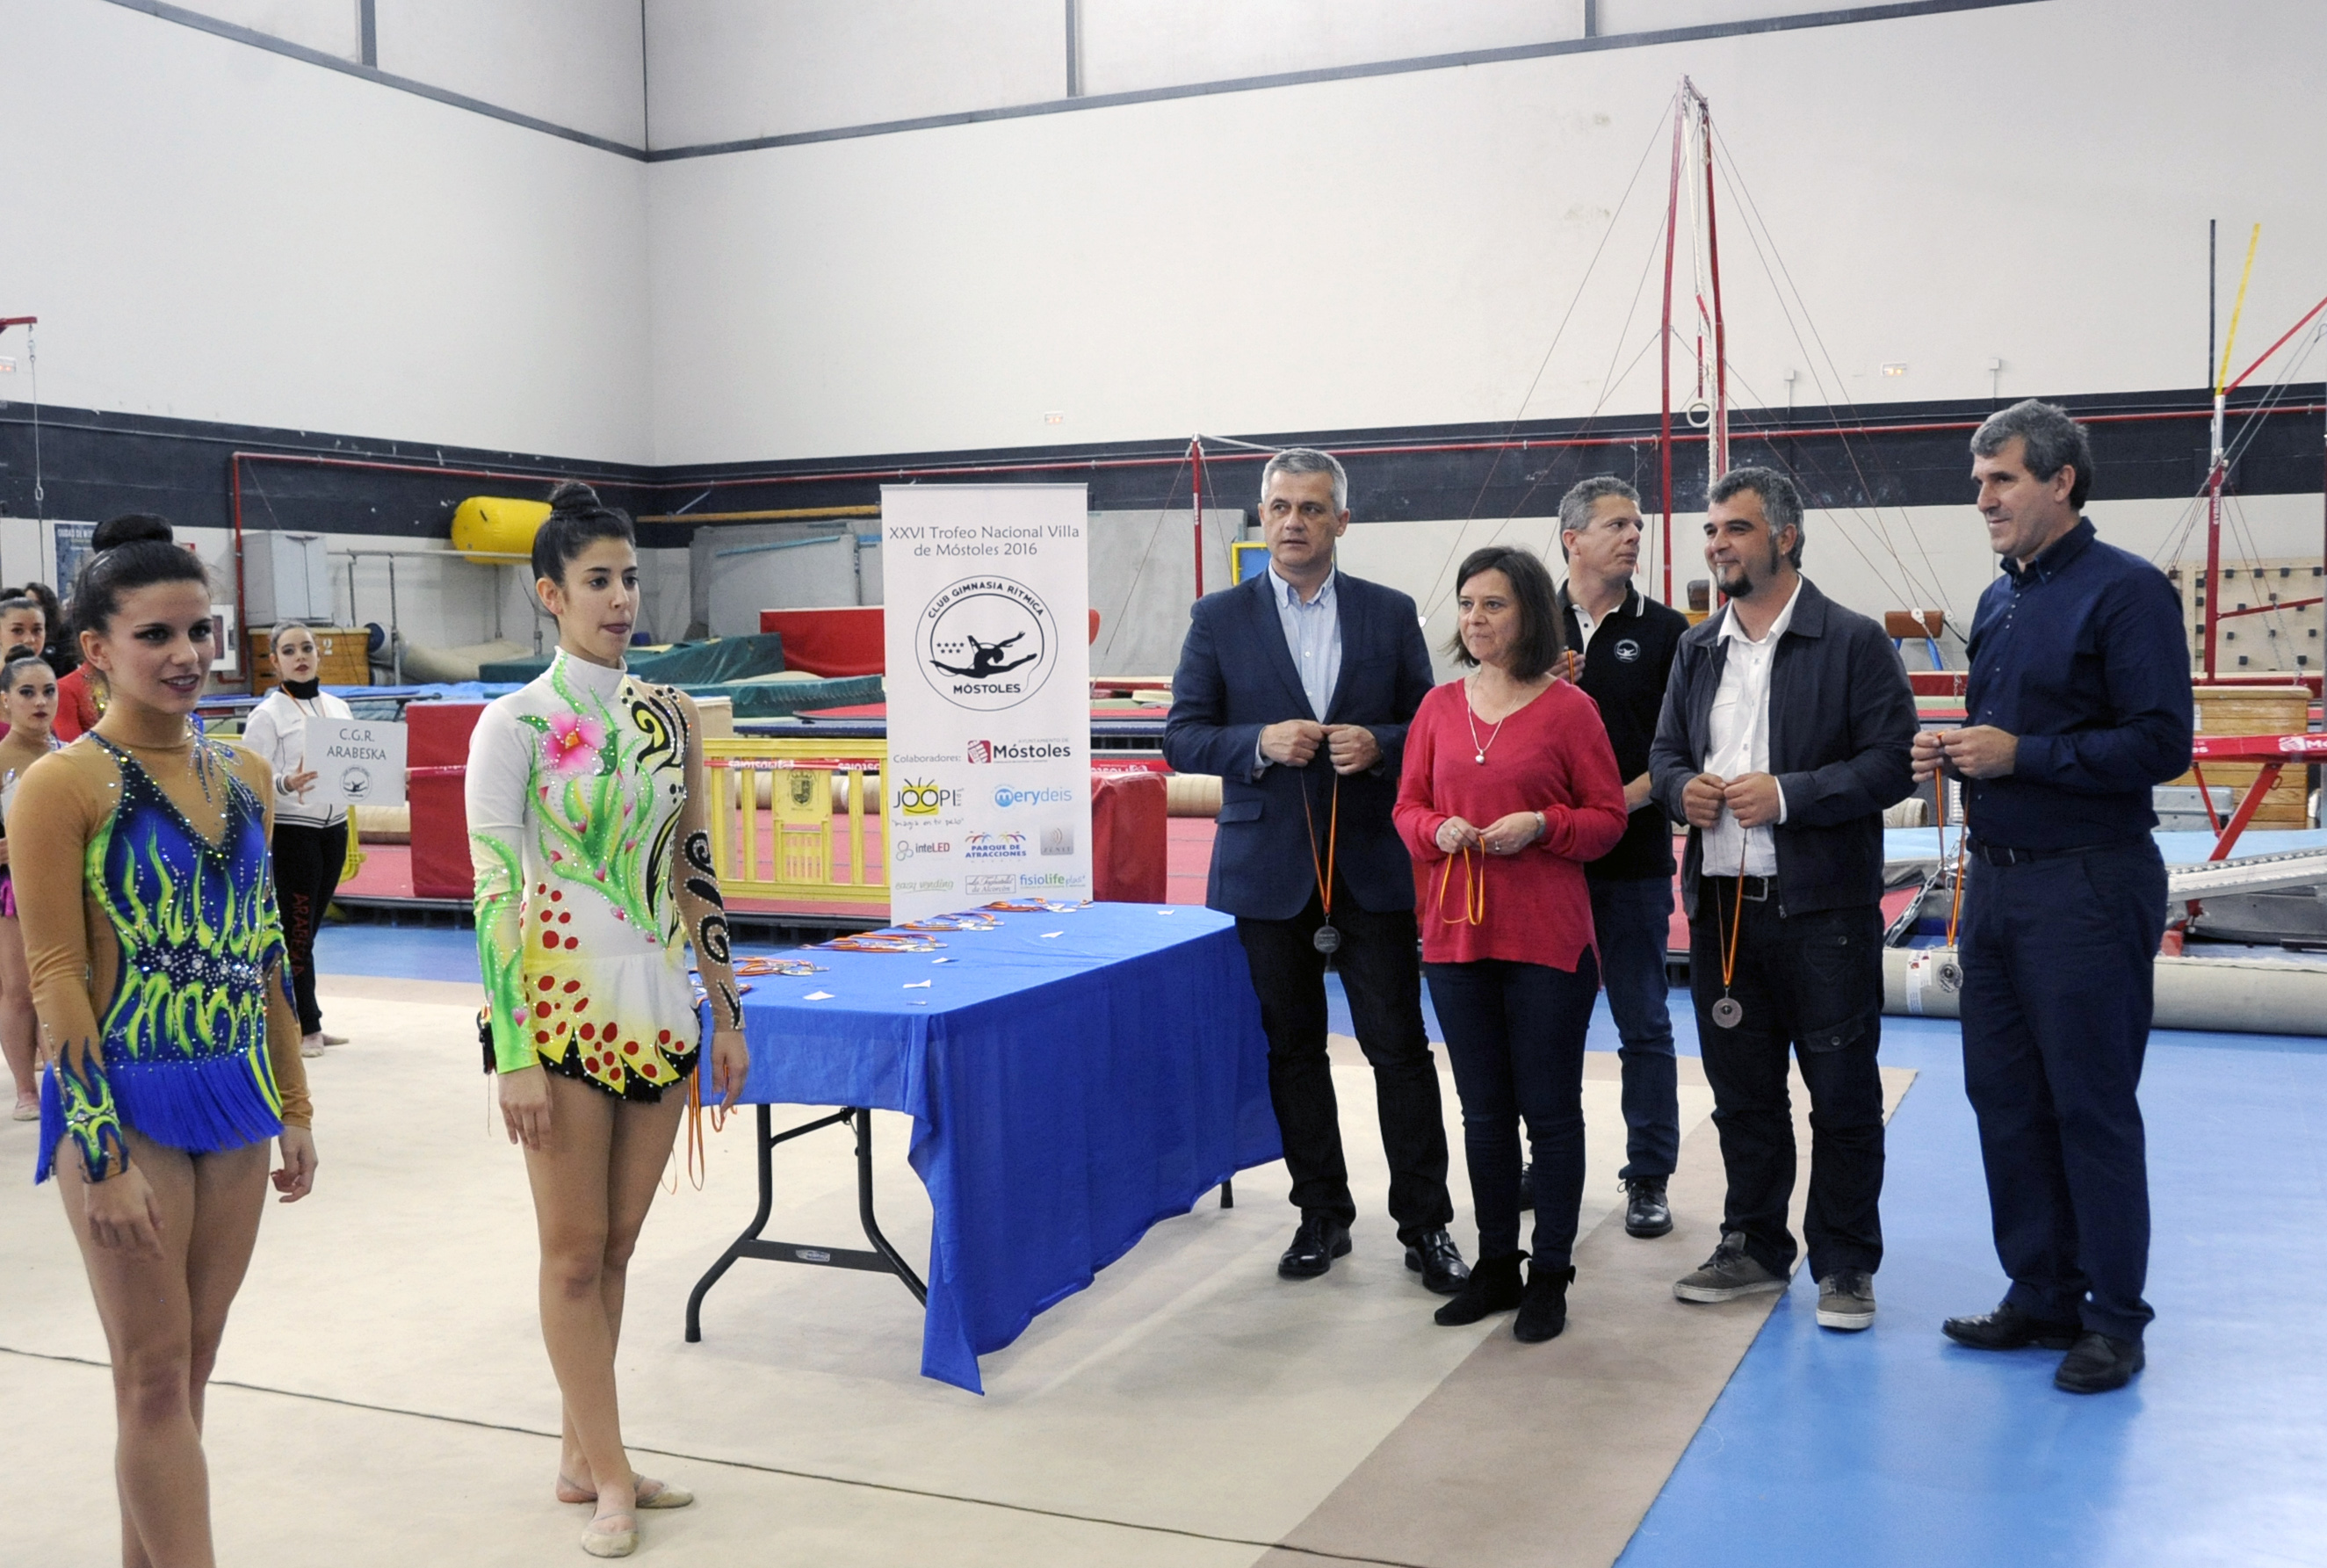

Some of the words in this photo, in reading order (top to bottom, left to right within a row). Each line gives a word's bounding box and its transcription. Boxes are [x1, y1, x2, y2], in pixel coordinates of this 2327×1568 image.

[889, 526, 924, 539] XXVI
[929, 526, 977, 539] Trofeo
[981, 525, 1043, 538] Nacional
[1048, 524, 1080, 538] Villa
[914, 544, 931, 556] de
[936, 543, 999, 556] Móstoles
[1004, 543, 1037, 555] 2016
[928, 595, 950, 618] CLUB
[951, 581, 1003, 596] GIMNASIA
[322, 638, 333, 655] 2
[953, 683, 1021, 694] MÓSTOLES
[339, 728, 375, 742] C.G.R.
[327, 746, 387, 760] ARABESKA
[994, 743, 1071, 759] Móstoles
[892, 754, 962, 763] Colaboradores:
[892, 789, 956, 808] JOOPI
[915, 842, 950, 853] inteLED
